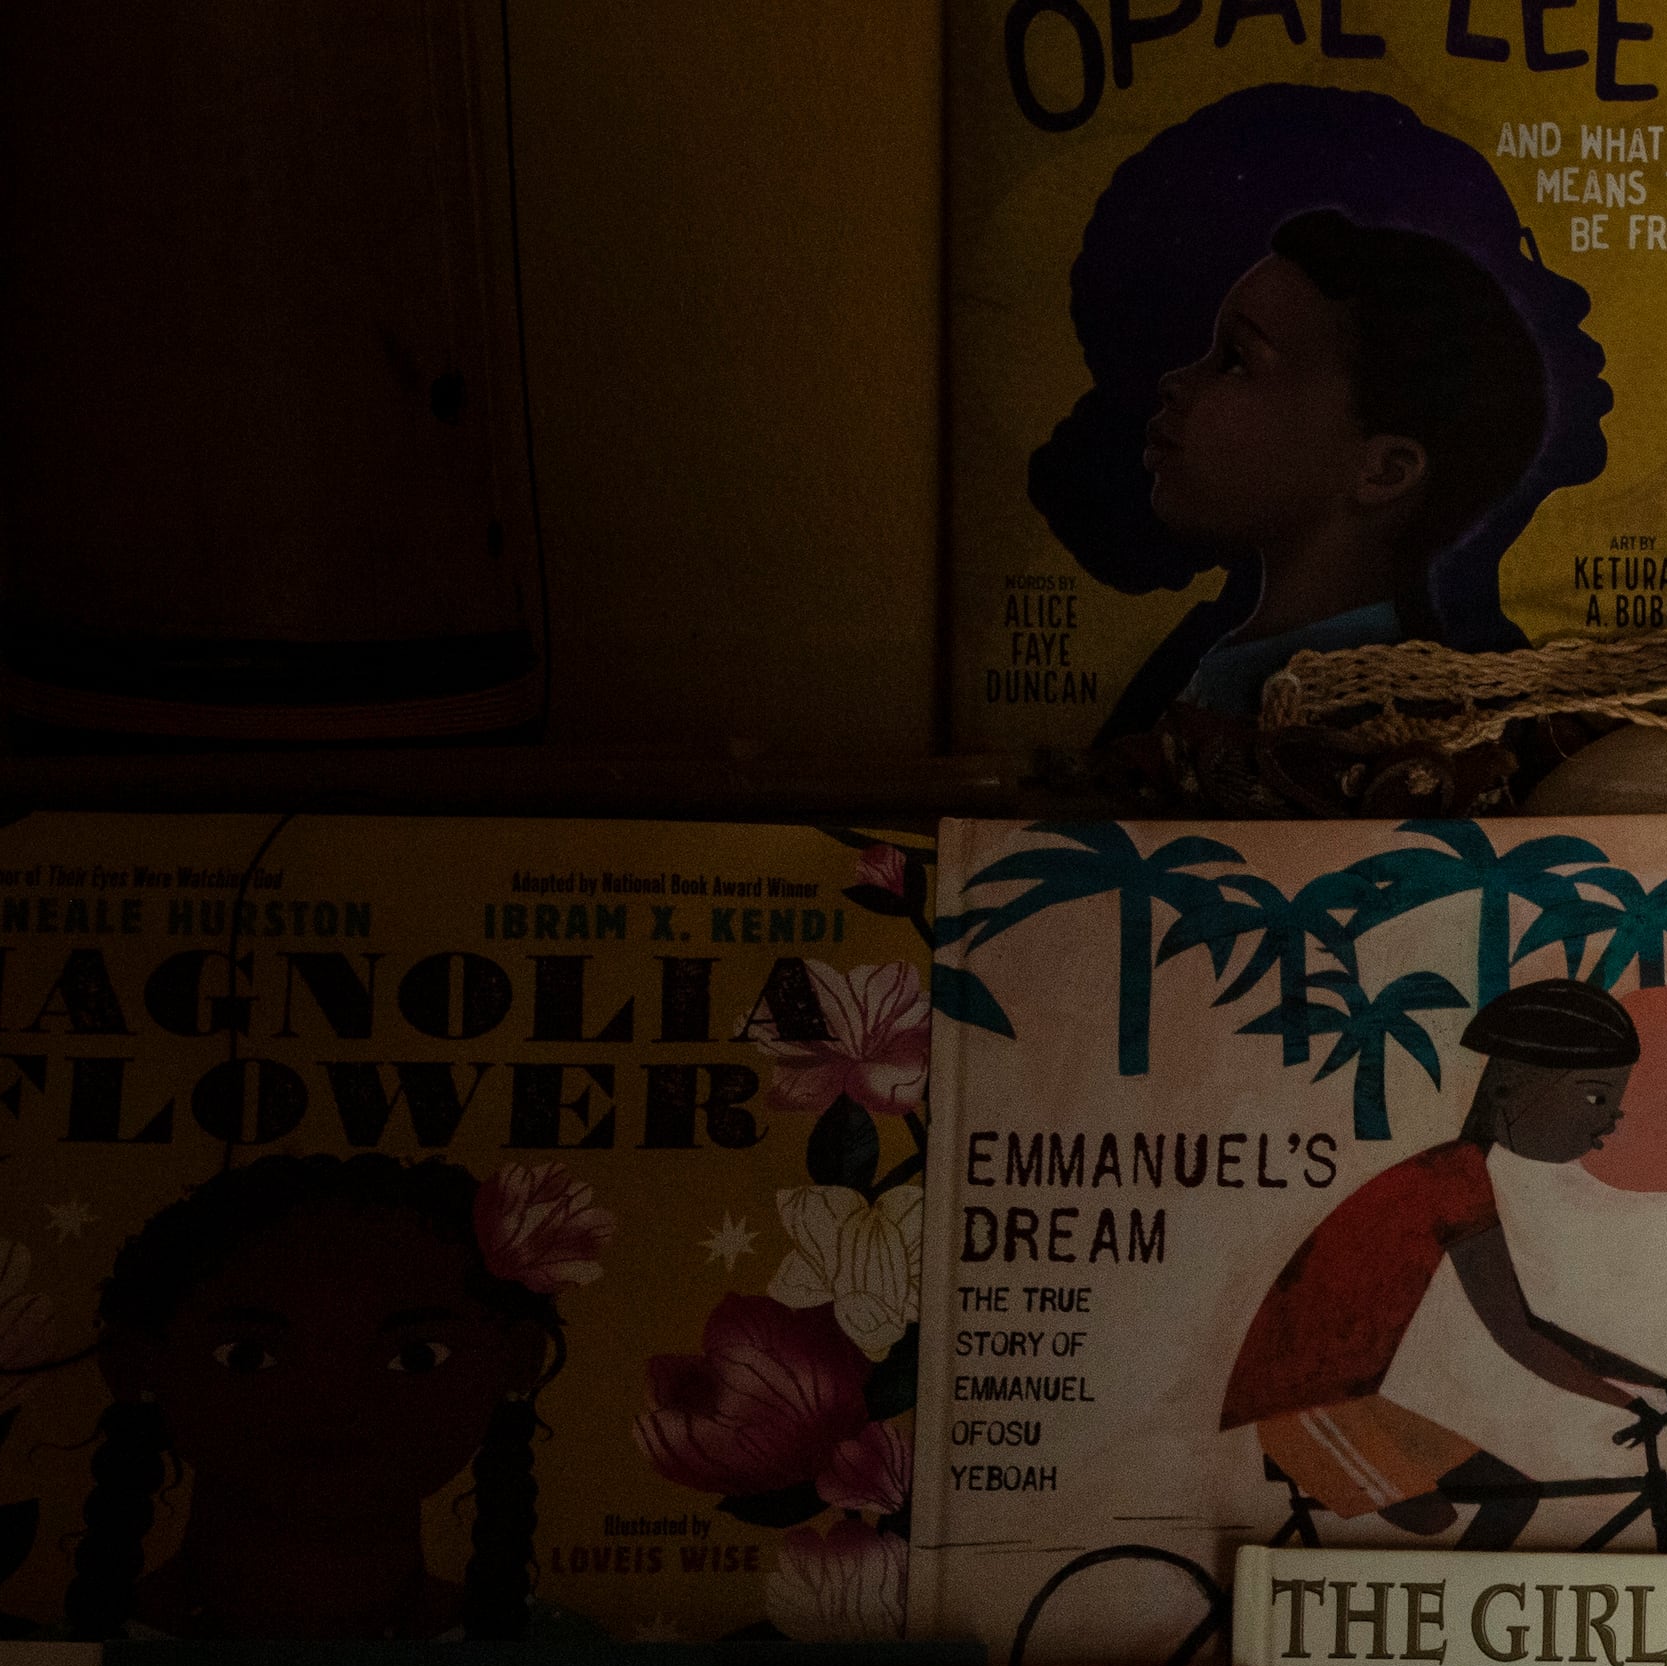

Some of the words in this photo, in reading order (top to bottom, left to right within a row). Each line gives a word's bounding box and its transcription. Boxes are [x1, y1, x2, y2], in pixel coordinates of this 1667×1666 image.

[1497, 122, 1561, 159] AND
[1581, 124, 1665, 163] WHAT
[1536, 170, 1648, 208] MEANS
[1571, 216, 1609, 252] BE
[1004, 595, 1078, 629] ALICE
[1586, 598, 1609, 628] A.
[1011, 634, 1071, 666] FAYE
[987, 671, 1097, 704] DUNCAN
[512, 872, 573, 893] Adapted
[579, 872, 596, 894] by
[602, 874, 666, 894] National
[672, 875, 707, 894] Book
[713, 877, 761, 897] Award
[767, 878, 818, 898] Winner
[2, 902, 143, 936] NEALE
[167, 902, 372, 938] HURSTON
[484, 905, 627, 940] IBRAM
[650, 906, 691, 941] X.
[710, 907, 846, 944] KENDI
[0, 947, 840, 1043] AGNOLIA
[961, 1206, 1166, 1264] DREAM
[958, 1287, 1010, 1312] THE
[1023, 1287, 1092, 1312] TRUE
[956, 1331, 1044, 1357] STORY
[1052, 1332, 1087, 1356] OF
[955, 1376, 1094, 1401] EMMANUEL
[952, 1421, 1041, 1446] OFOSU
[951, 1466, 1057, 1491] YEBOAH
[680, 1545, 761, 1572] WISE
[1273, 1577, 1448, 1662] THE
